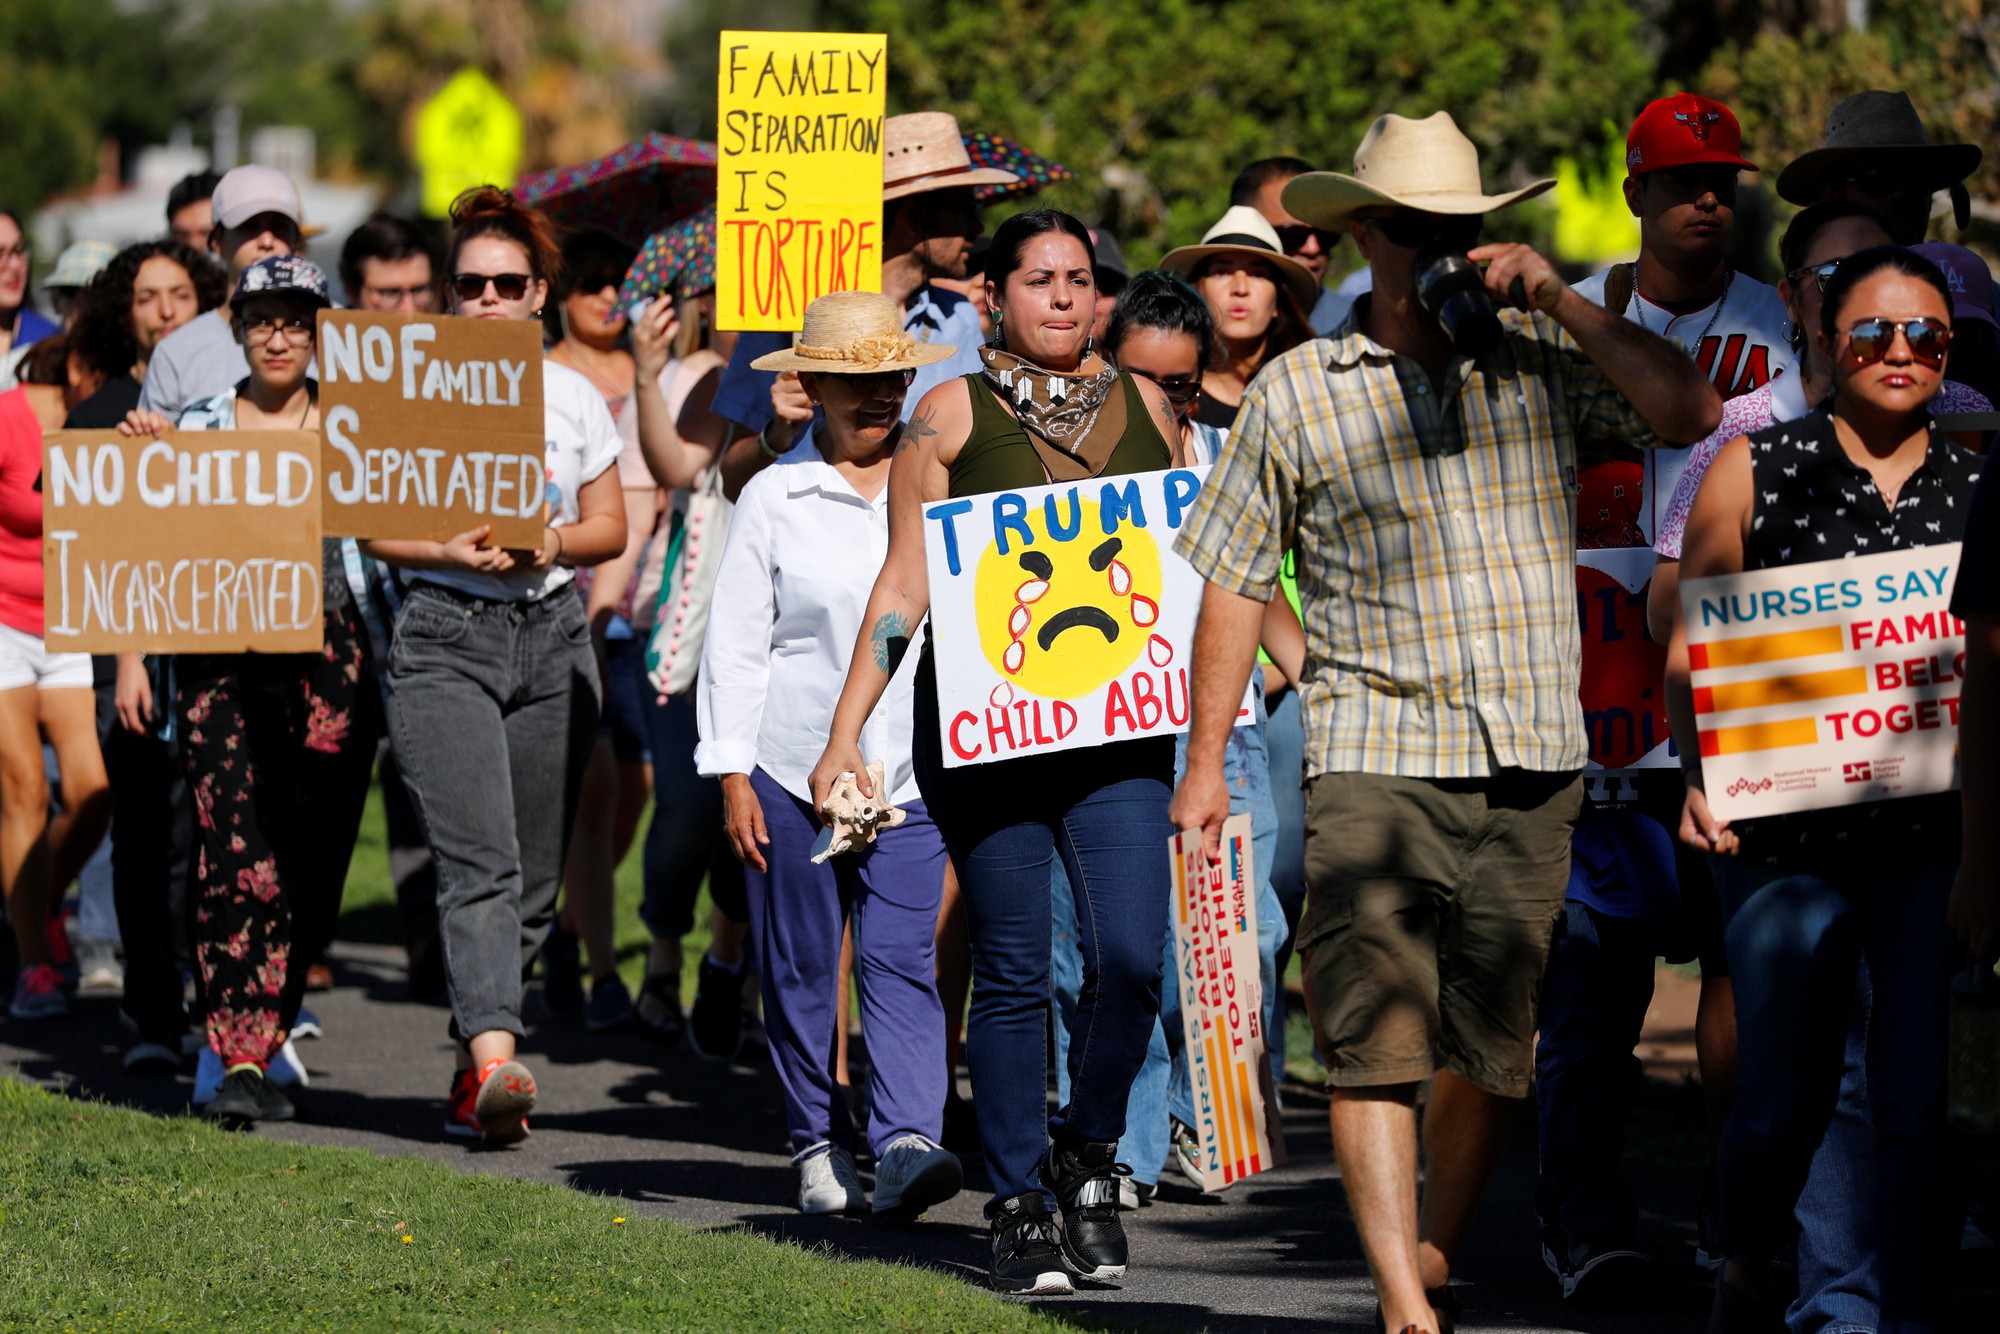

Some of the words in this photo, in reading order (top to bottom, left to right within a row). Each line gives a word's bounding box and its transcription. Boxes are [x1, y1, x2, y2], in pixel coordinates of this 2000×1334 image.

[729, 44, 883, 98] FAMILY
[724, 109, 883, 157] SEPARATION
[734, 170, 787, 213] IS
[321, 320, 394, 384] NO
[400, 323, 527, 407] FAMILY
[49, 443, 125, 507] NO
[136, 441, 314, 508] CHILD
[325, 404, 545, 519] SEPATATED
[926, 470, 1201, 577] TRUMP
[49, 530, 319, 636] INCARCERATED
[1702, 579, 1862, 627] NURSES
[1875, 566, 1949, 603] SAY
[949, 700, 1078, 760] CHILD
[1186, 849, 1211, 1031] FAMILIES
[1196, 847, 1224, 1007] BELONG
[1180, 938, 1198, 1006] SAY
[1190, 1019, 1218, 1171] NURSES
[1074, 1178, 1114, 1208] NIKE
